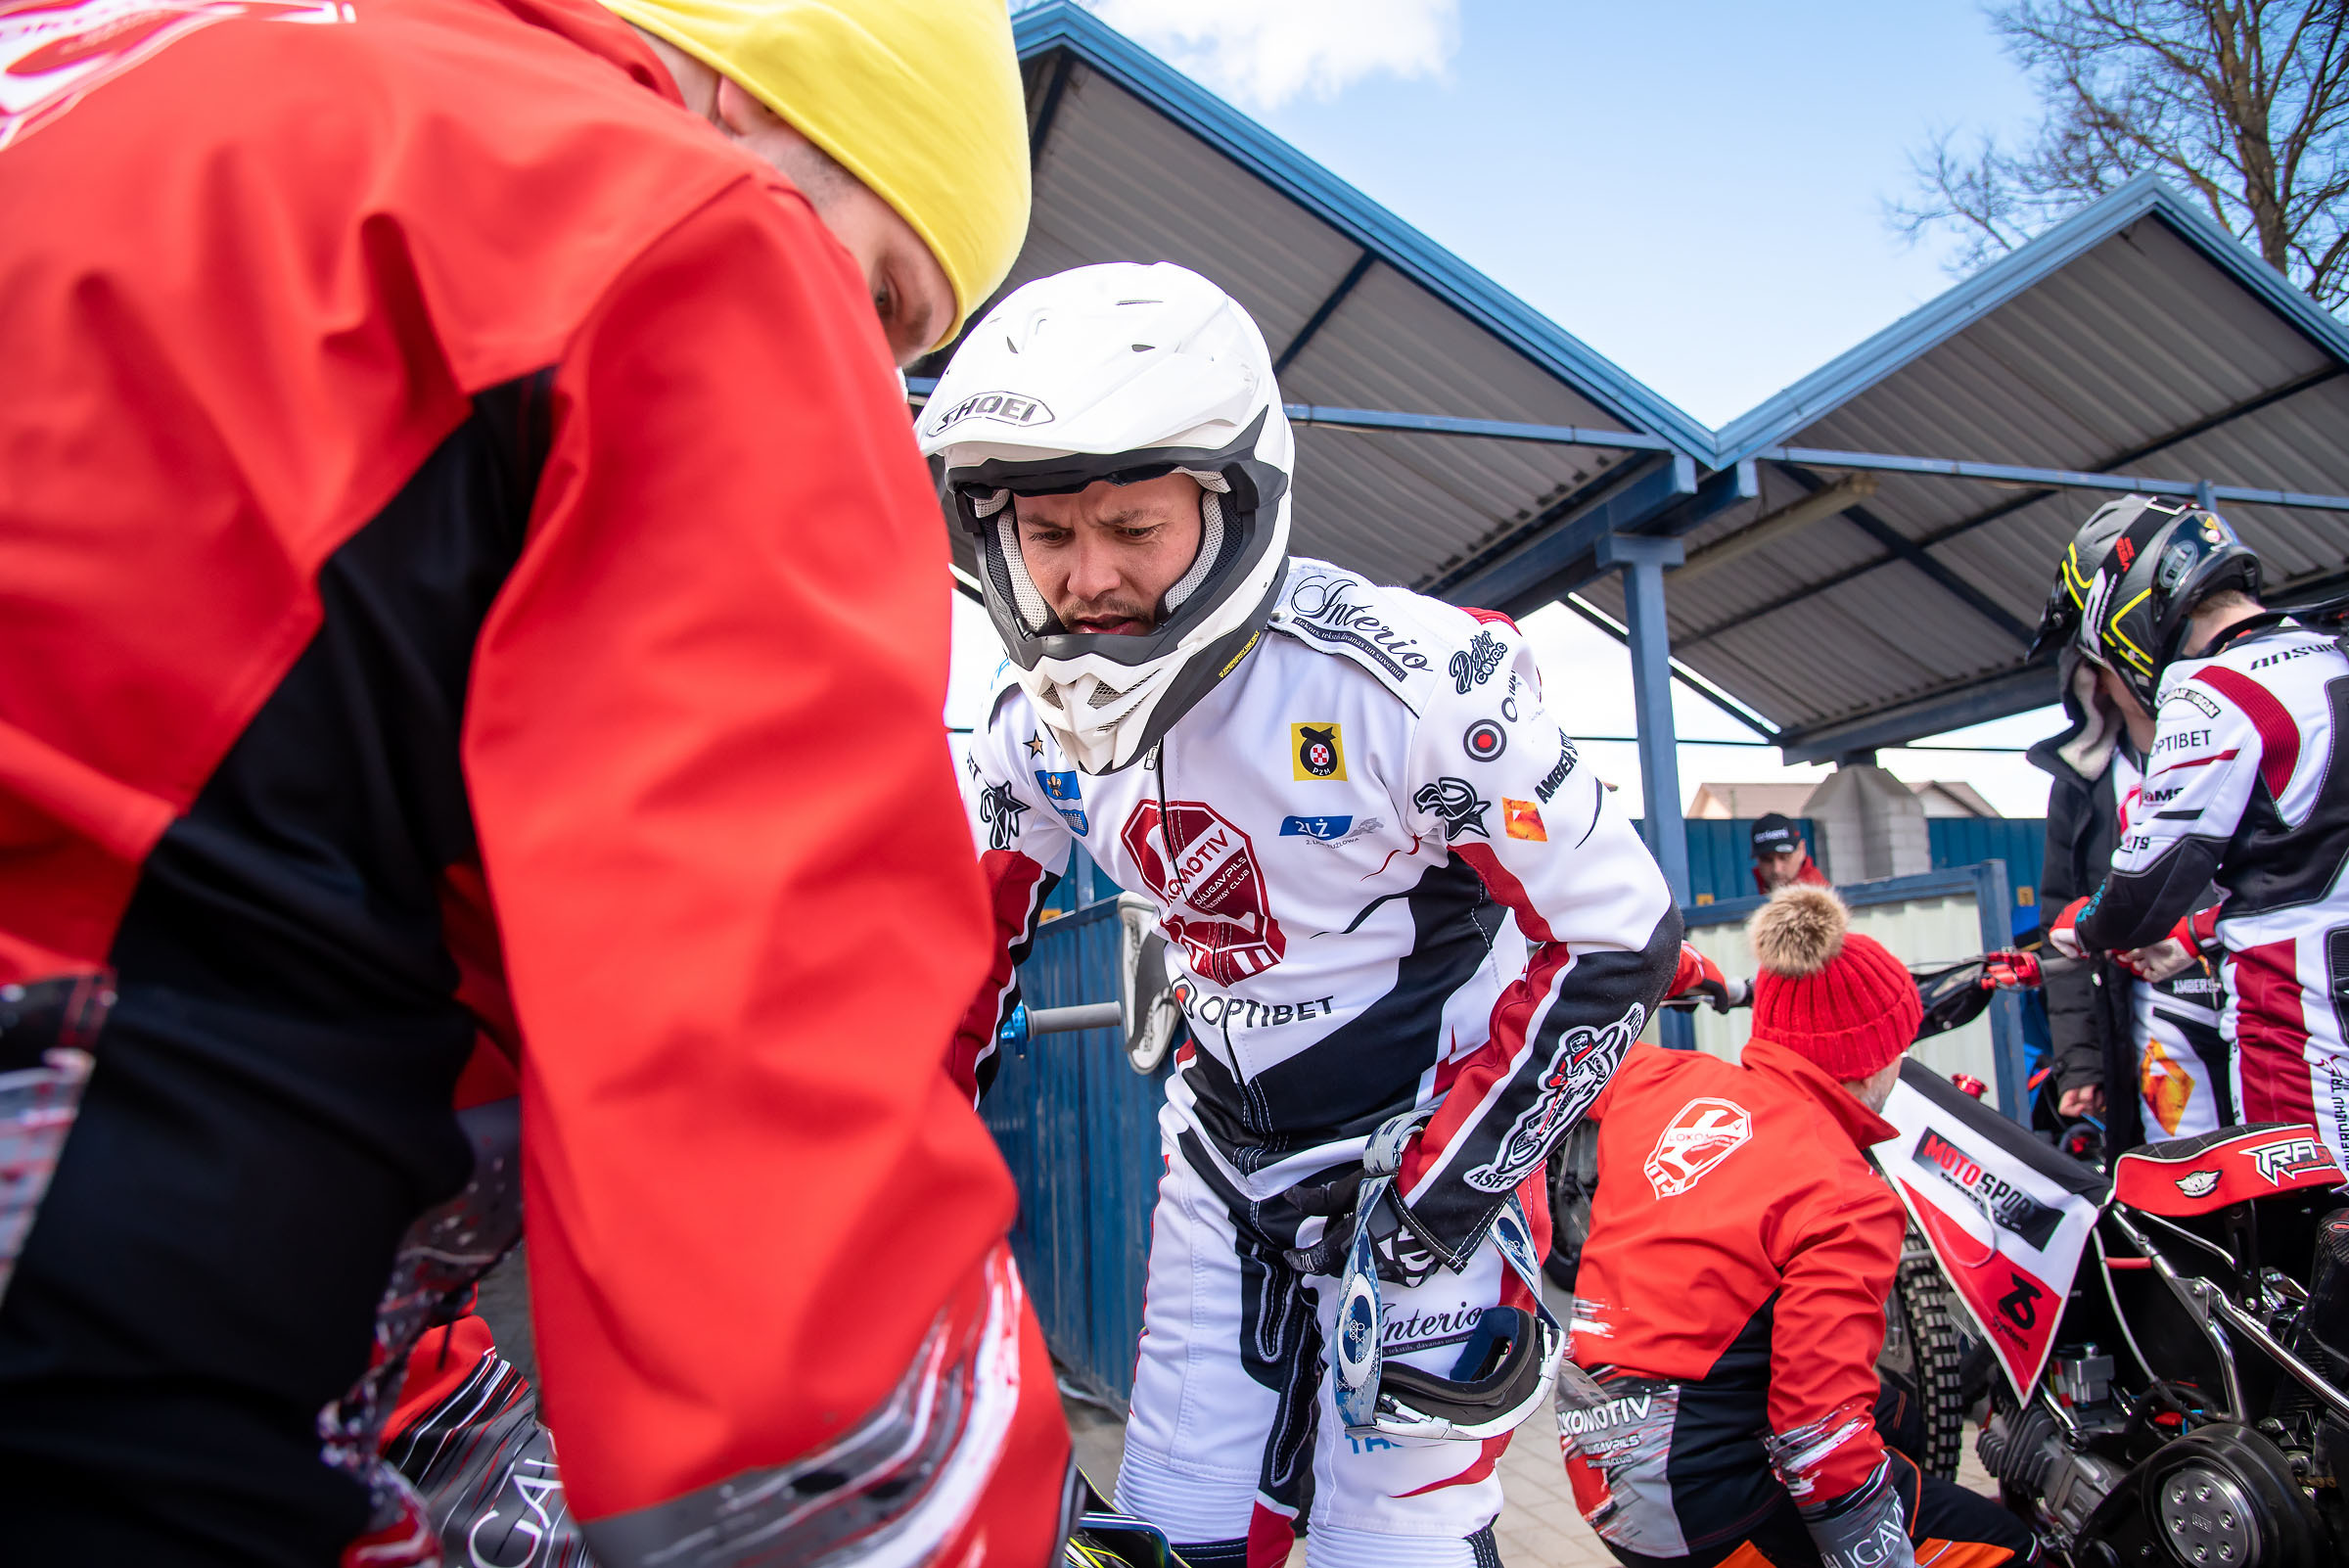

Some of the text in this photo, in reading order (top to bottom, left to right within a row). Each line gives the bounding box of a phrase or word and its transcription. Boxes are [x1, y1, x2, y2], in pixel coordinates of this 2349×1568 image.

[937, 395, 1037, 432] SHOEI
[1291, 576, 1433, 671] Interio
[1313, 766, 1331, 776] PZM
[1535, 750, 1578, 805] AMBER
[1229, 869, 1250, 890] CLUB
[1200, 995, 1334, 1028] OPTIBET
